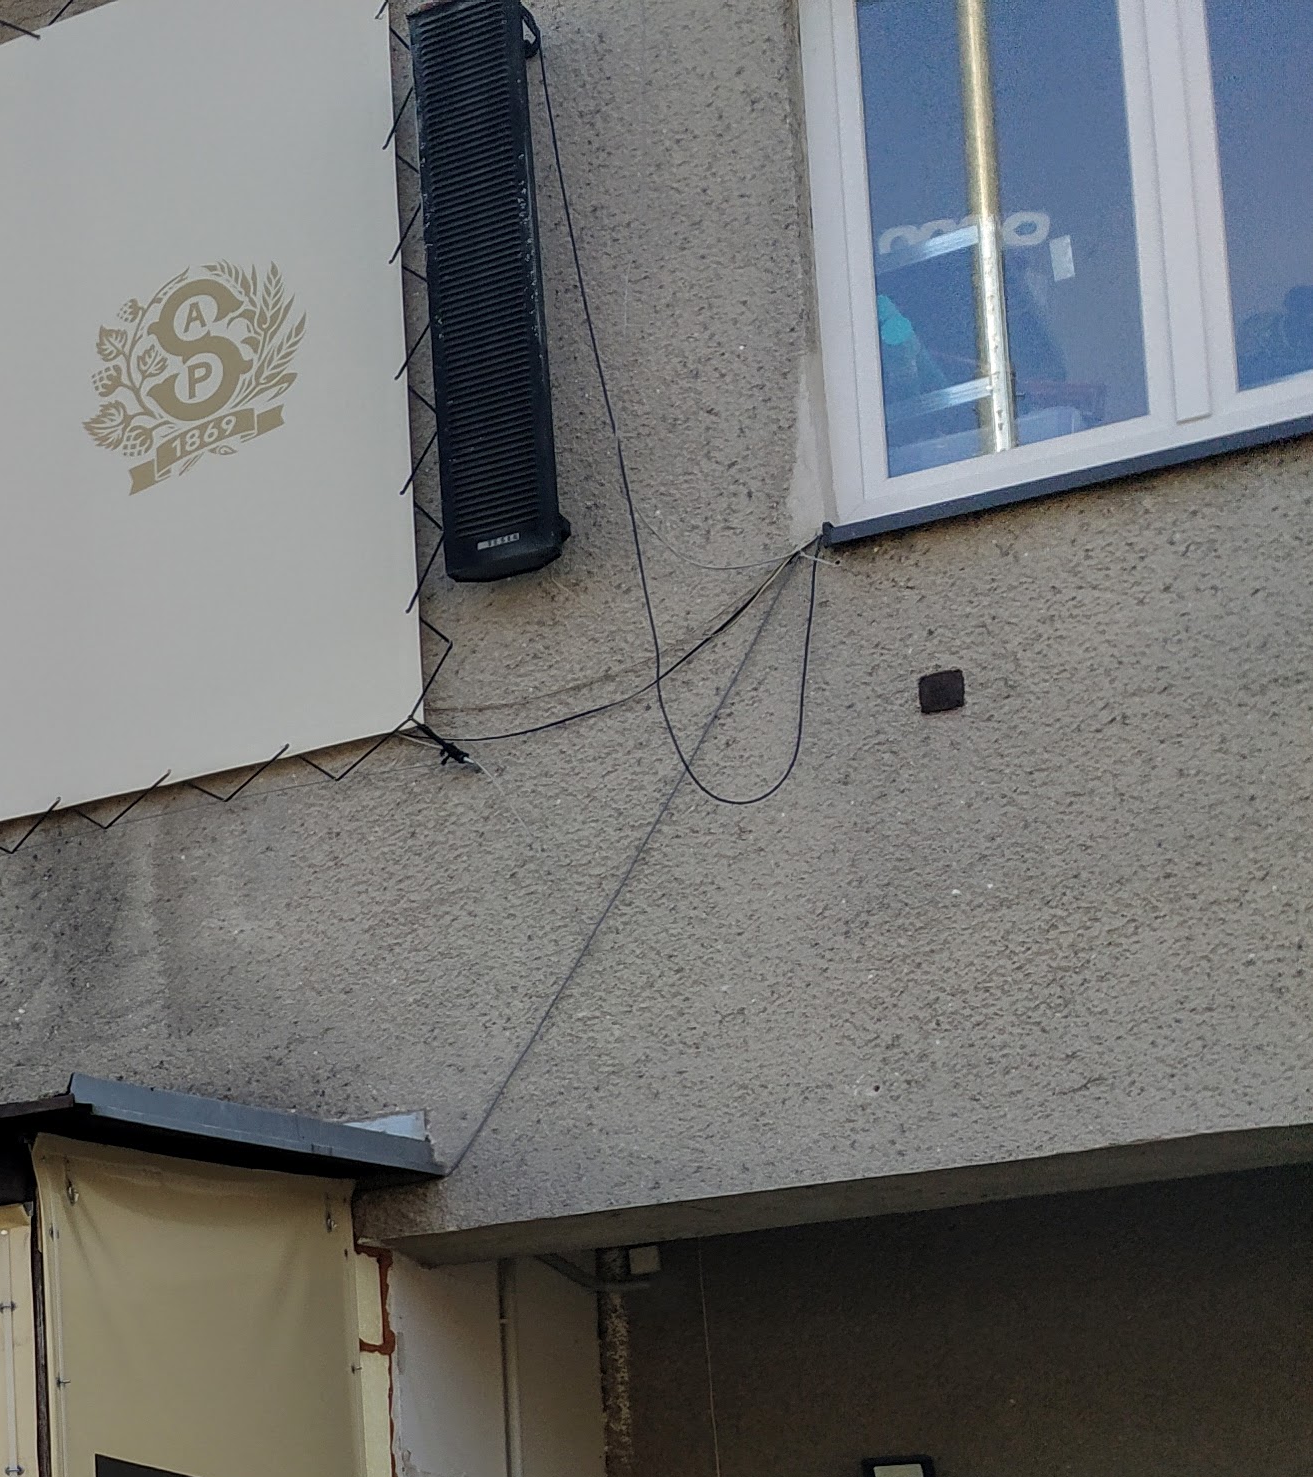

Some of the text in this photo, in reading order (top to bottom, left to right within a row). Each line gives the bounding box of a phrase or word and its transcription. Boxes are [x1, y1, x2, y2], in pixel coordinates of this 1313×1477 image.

[183, 301, 207, 333] A
[187, 361, 213, 399] P
[171, 414, 238, 457] 1869
